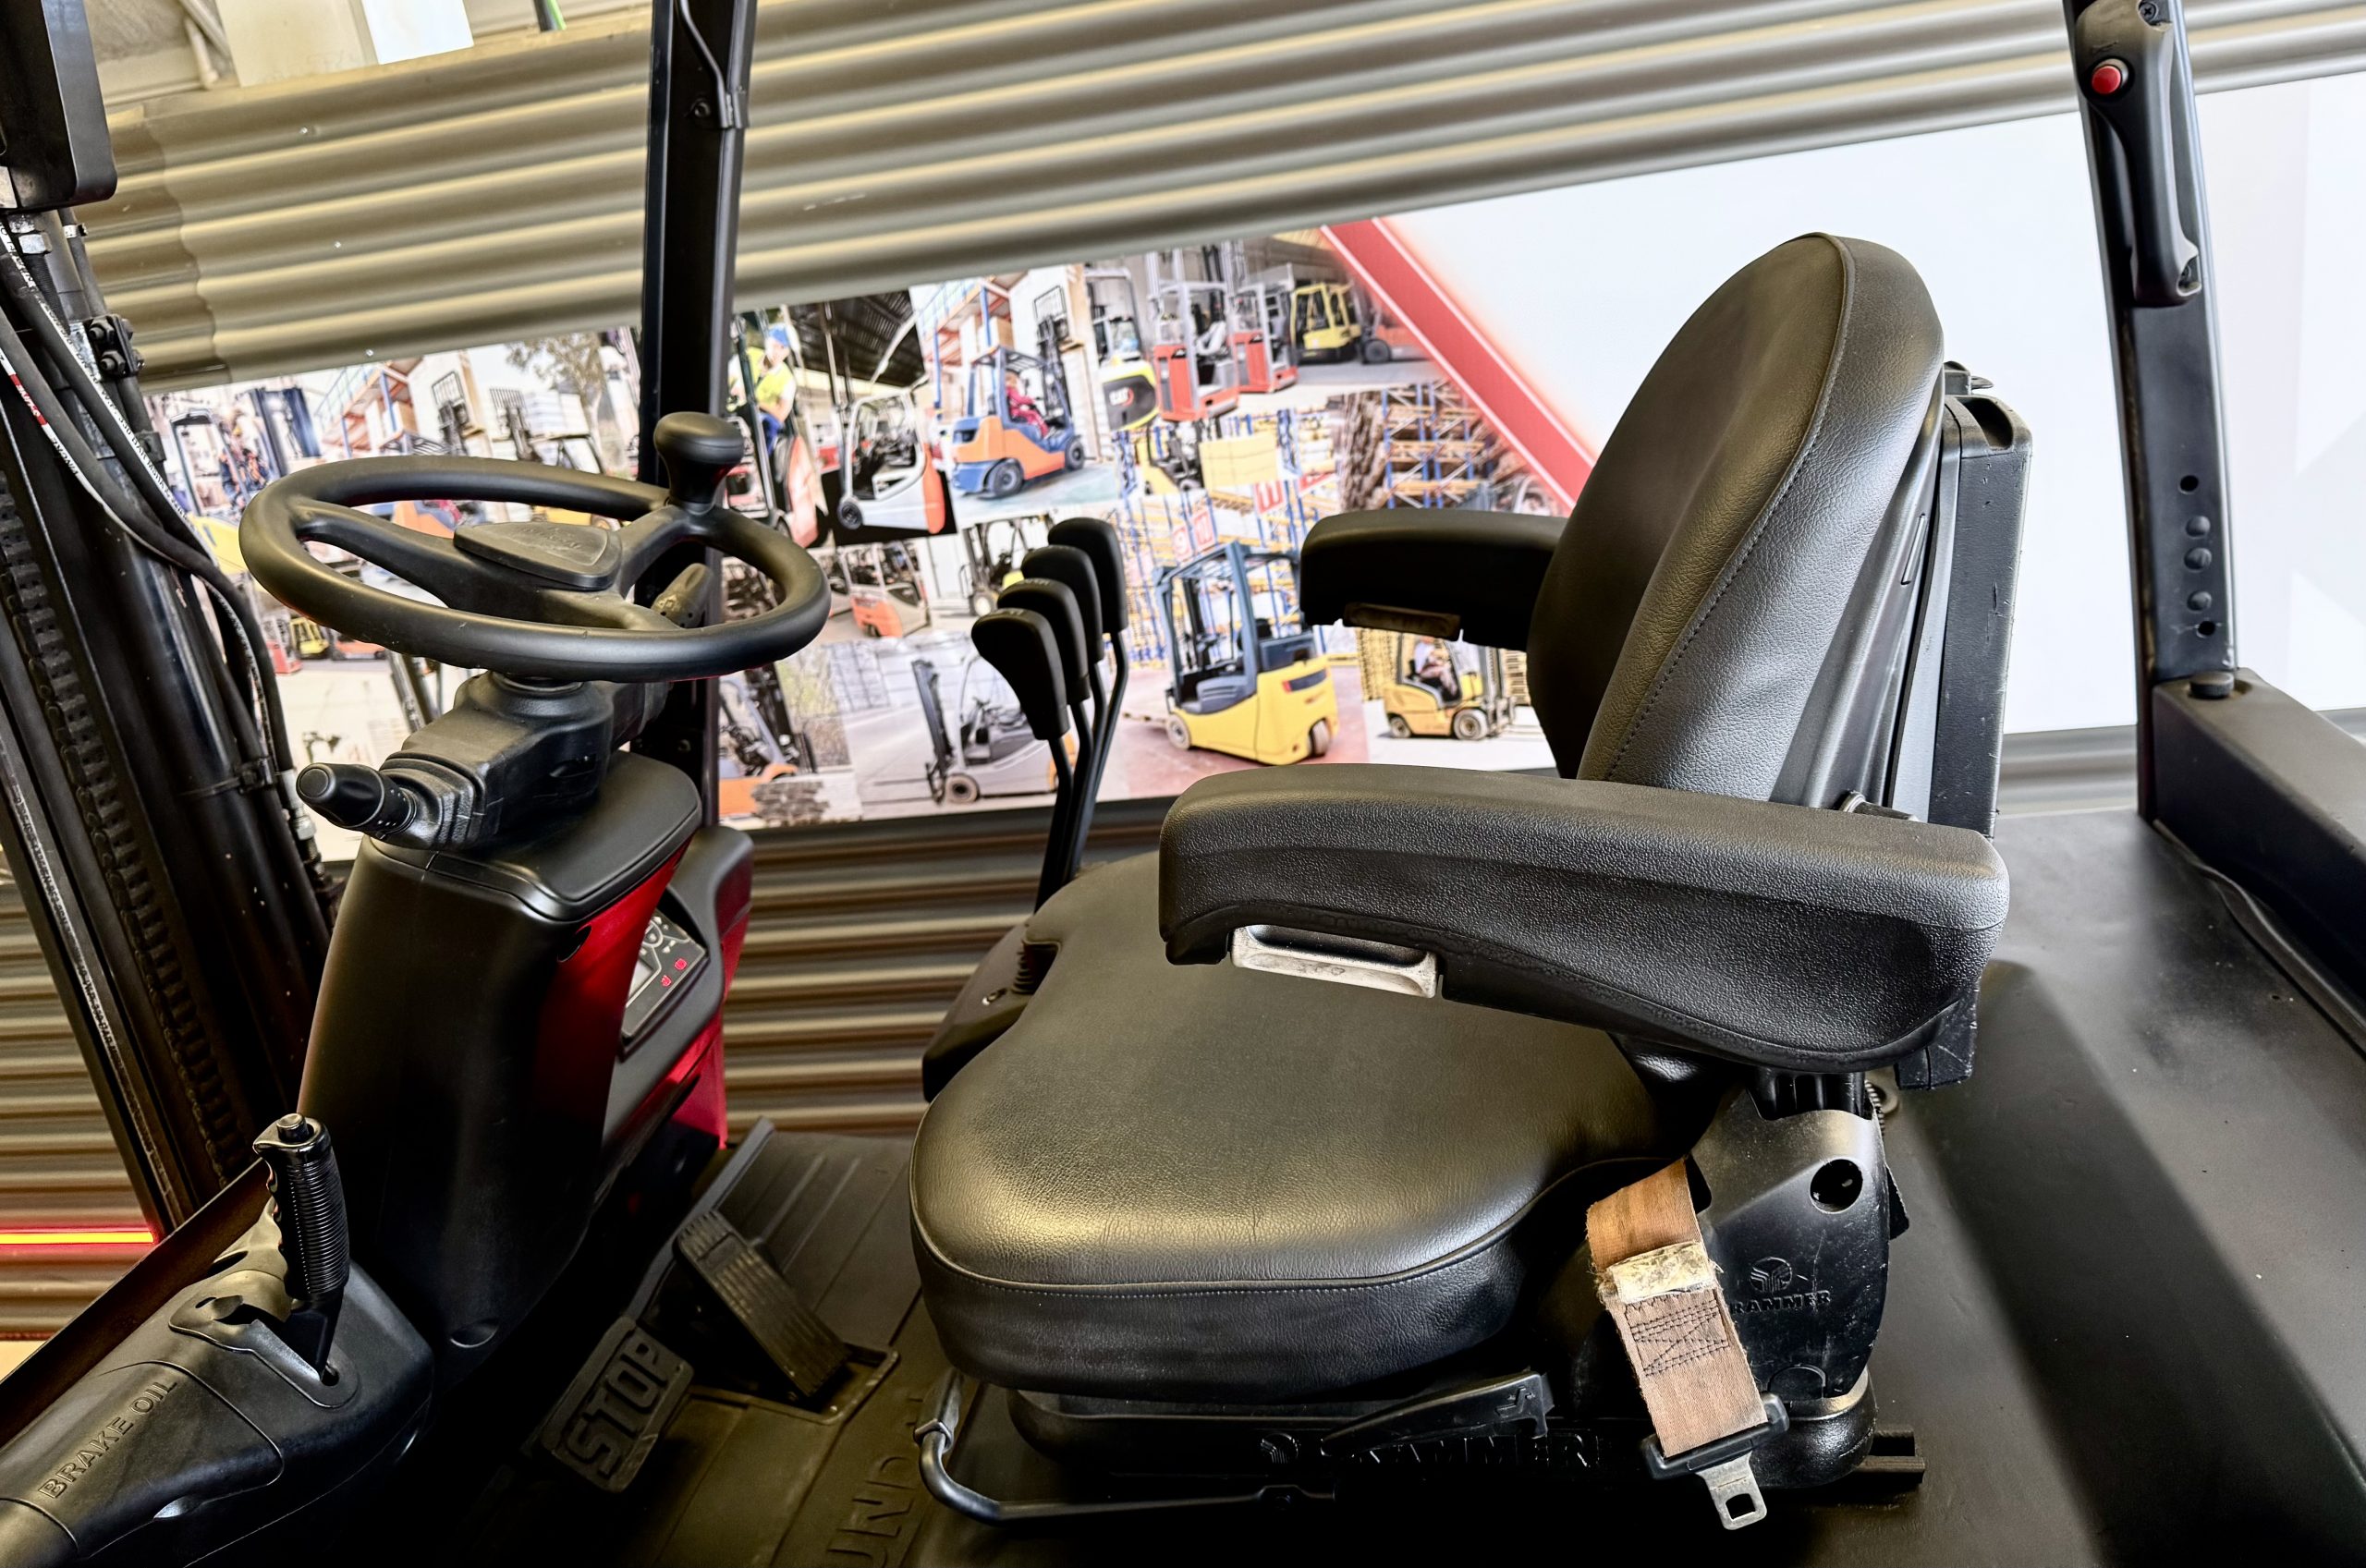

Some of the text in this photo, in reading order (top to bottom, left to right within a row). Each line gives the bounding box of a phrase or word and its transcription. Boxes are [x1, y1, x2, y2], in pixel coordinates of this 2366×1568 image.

[1727, 1289, 1832, 1316] RAMMER
[37, 1381, 178, 1499] BRAKE OIL
[565, 1336, 674, 1480] STOP
